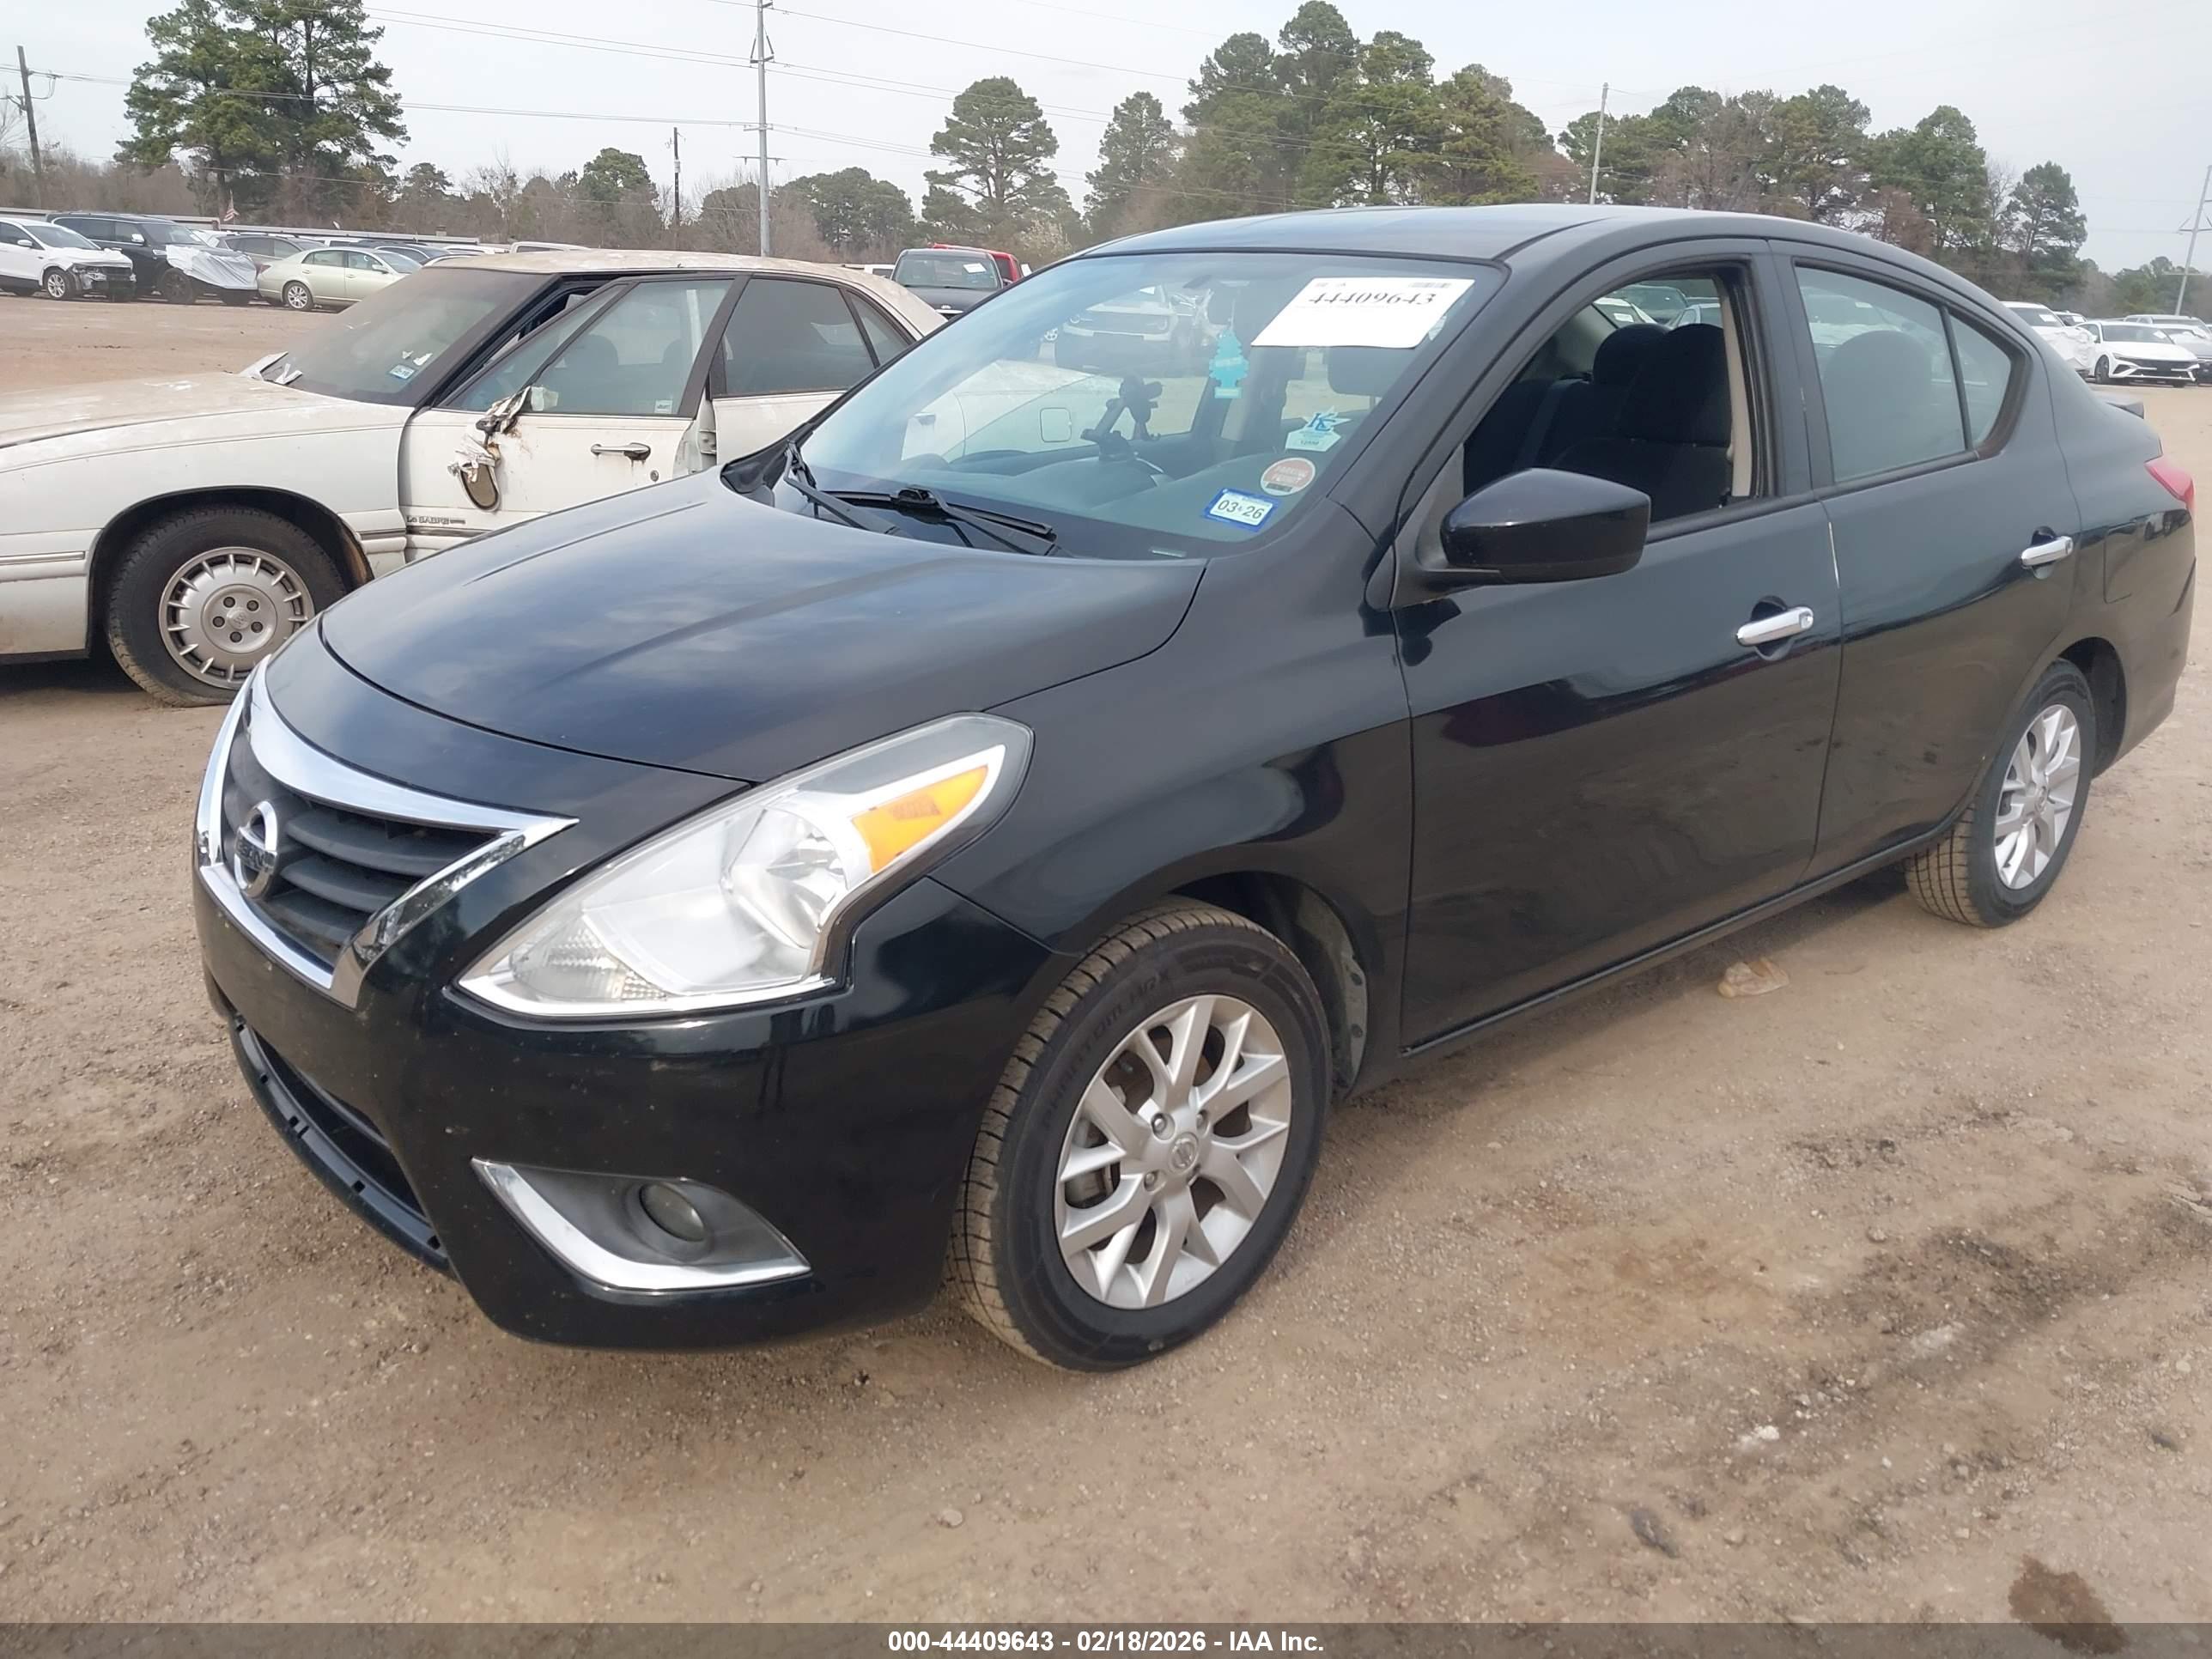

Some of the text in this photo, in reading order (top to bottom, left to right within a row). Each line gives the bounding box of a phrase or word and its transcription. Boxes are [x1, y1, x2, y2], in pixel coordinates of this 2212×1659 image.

[1308, 292, 1437, 305] 44409643
[1217, 500, 1239, 513] 03
[1242, 505, 1266, 520] 26
